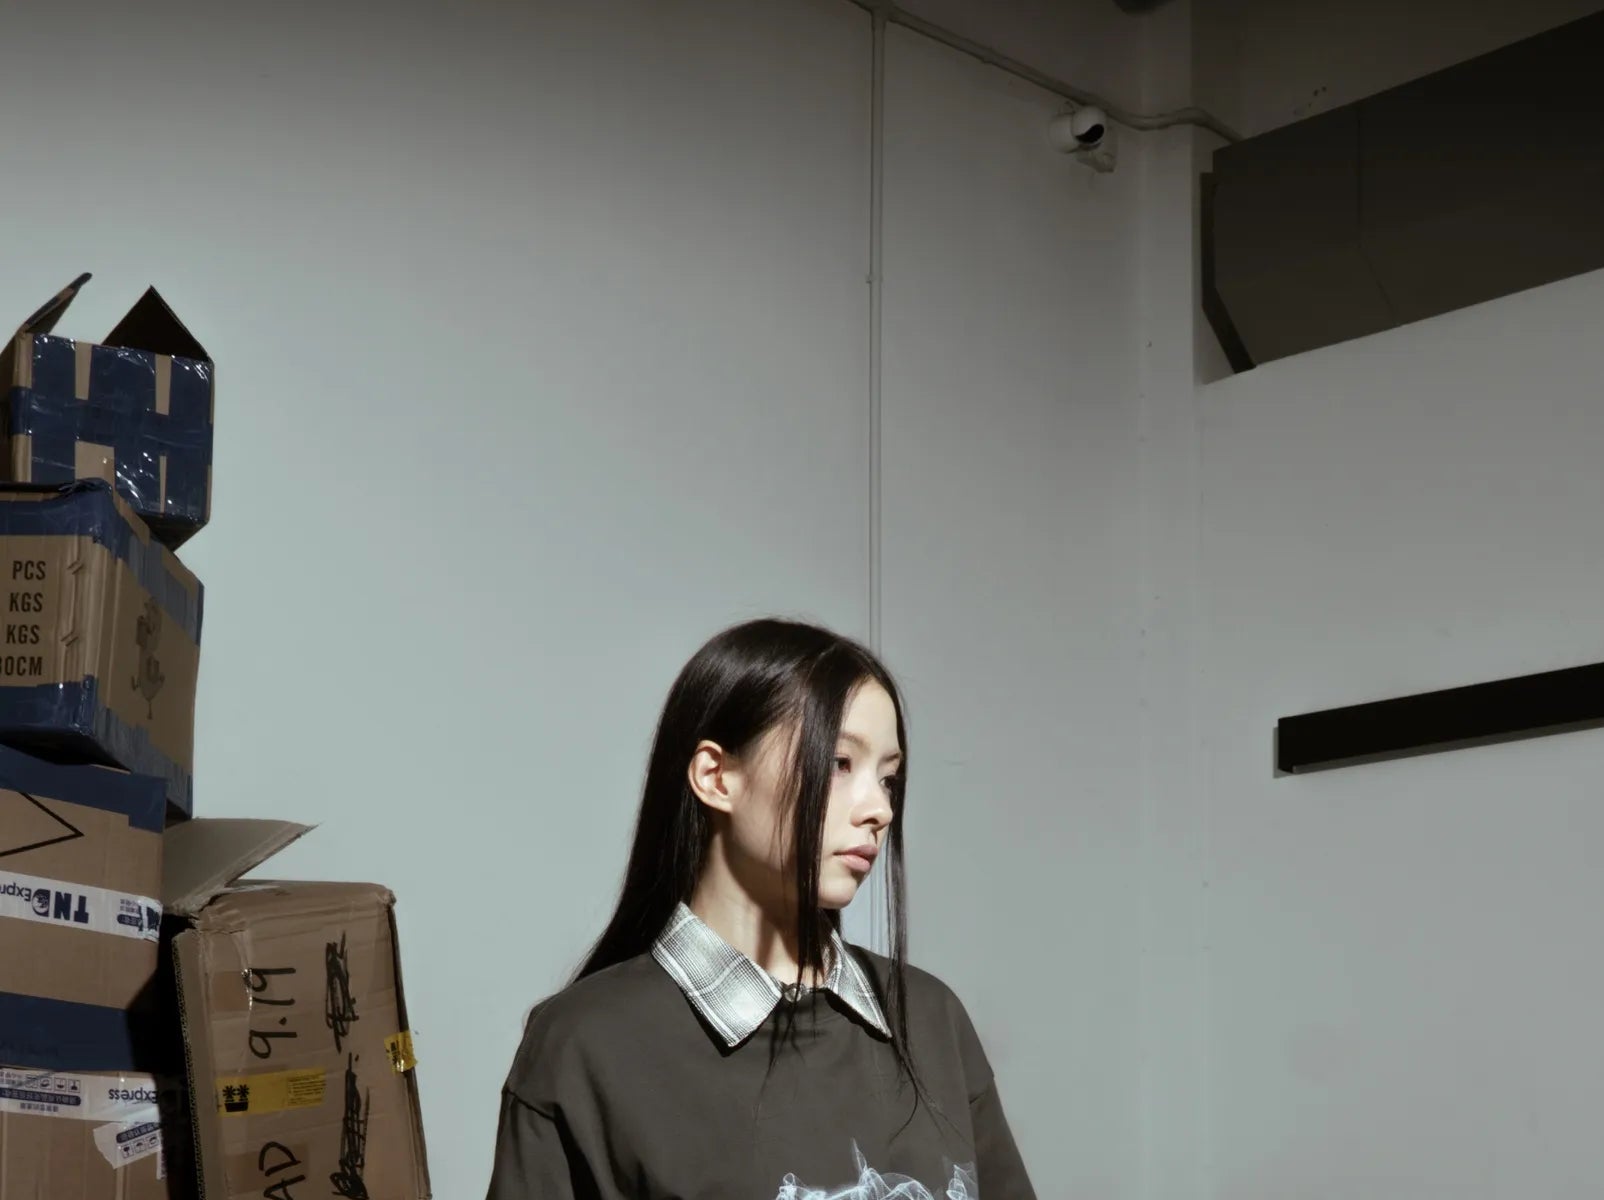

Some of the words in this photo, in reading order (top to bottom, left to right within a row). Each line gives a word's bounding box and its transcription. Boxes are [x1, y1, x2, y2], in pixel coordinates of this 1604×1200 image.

[12, 560, 46, 581] PCS
[9, 592, 44, 613] KGS
[6, 624, 40, 645] KGS
[0, 656, 43, 677] 0CM
[108, 1086, 158, 1105] Express
